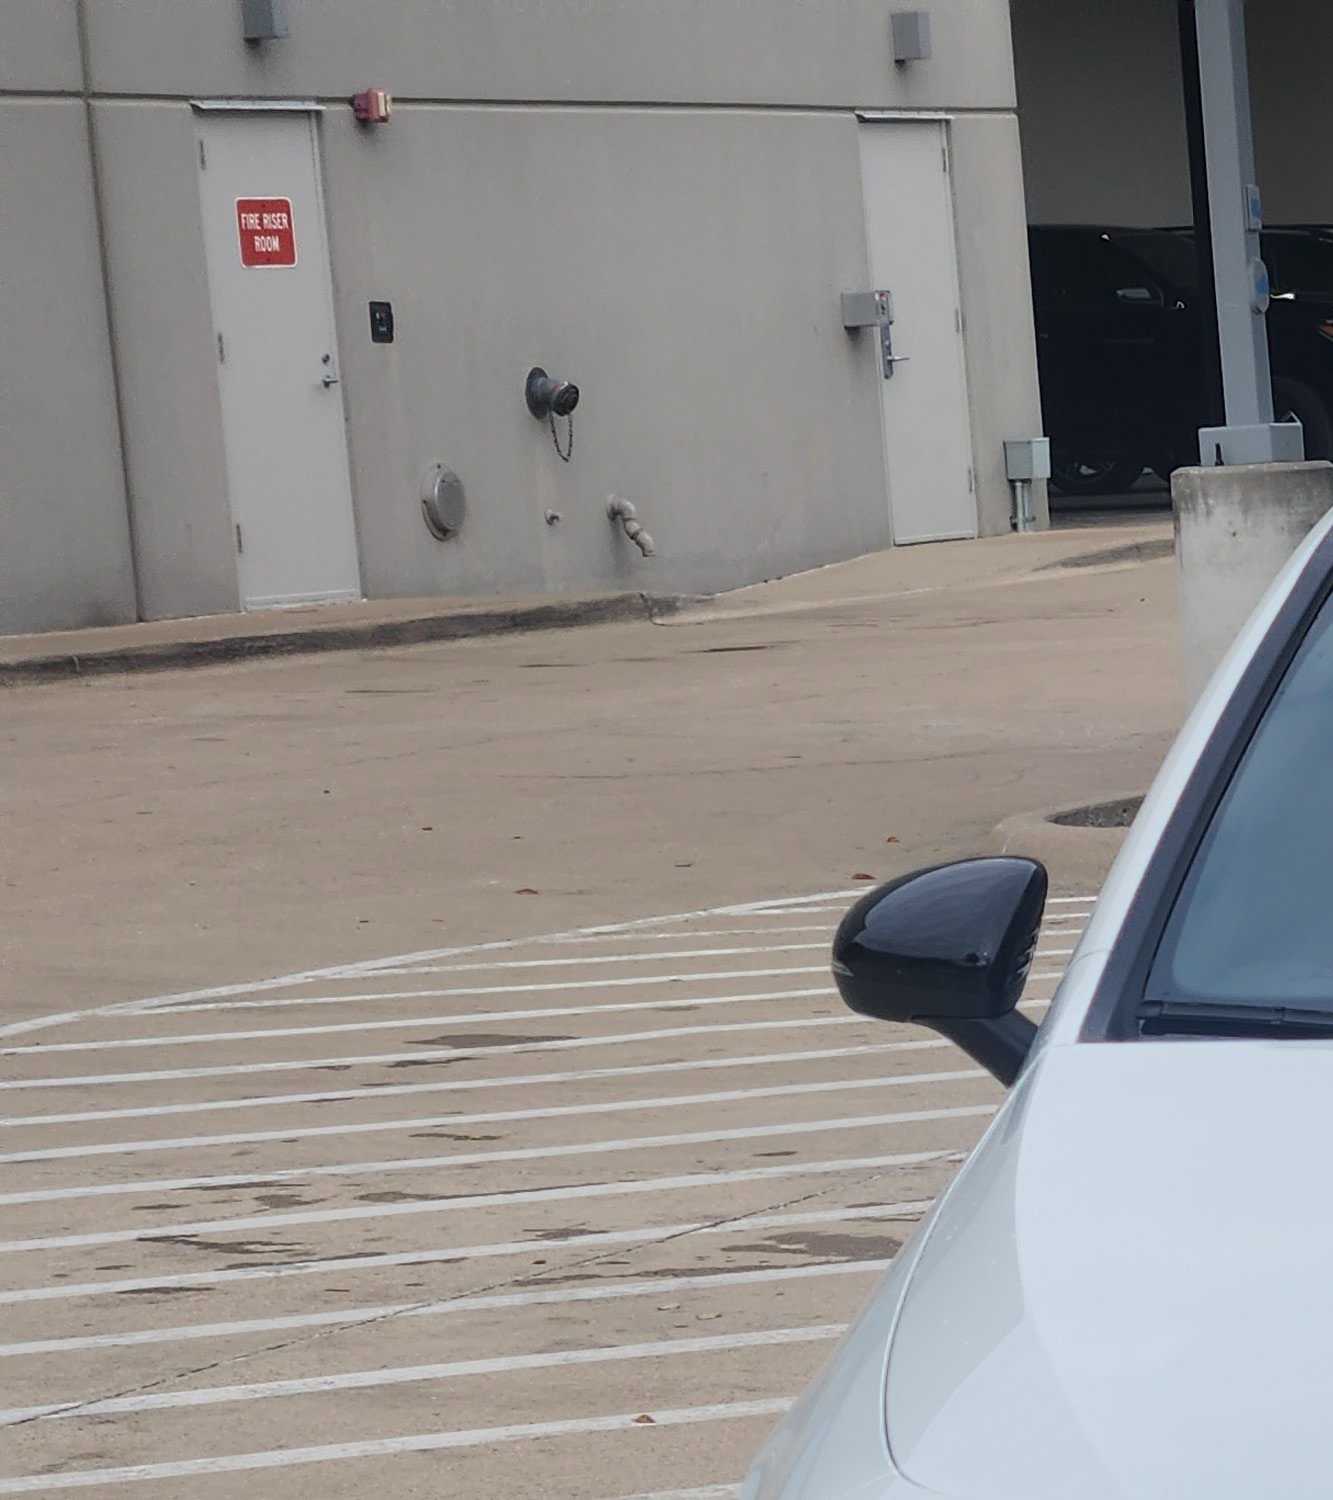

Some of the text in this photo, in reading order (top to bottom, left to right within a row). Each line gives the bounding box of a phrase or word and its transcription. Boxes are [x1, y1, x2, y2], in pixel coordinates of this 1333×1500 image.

[241, 213, 289, 230] FIRE RISER
[254, 236, 280, 252] ROOM
